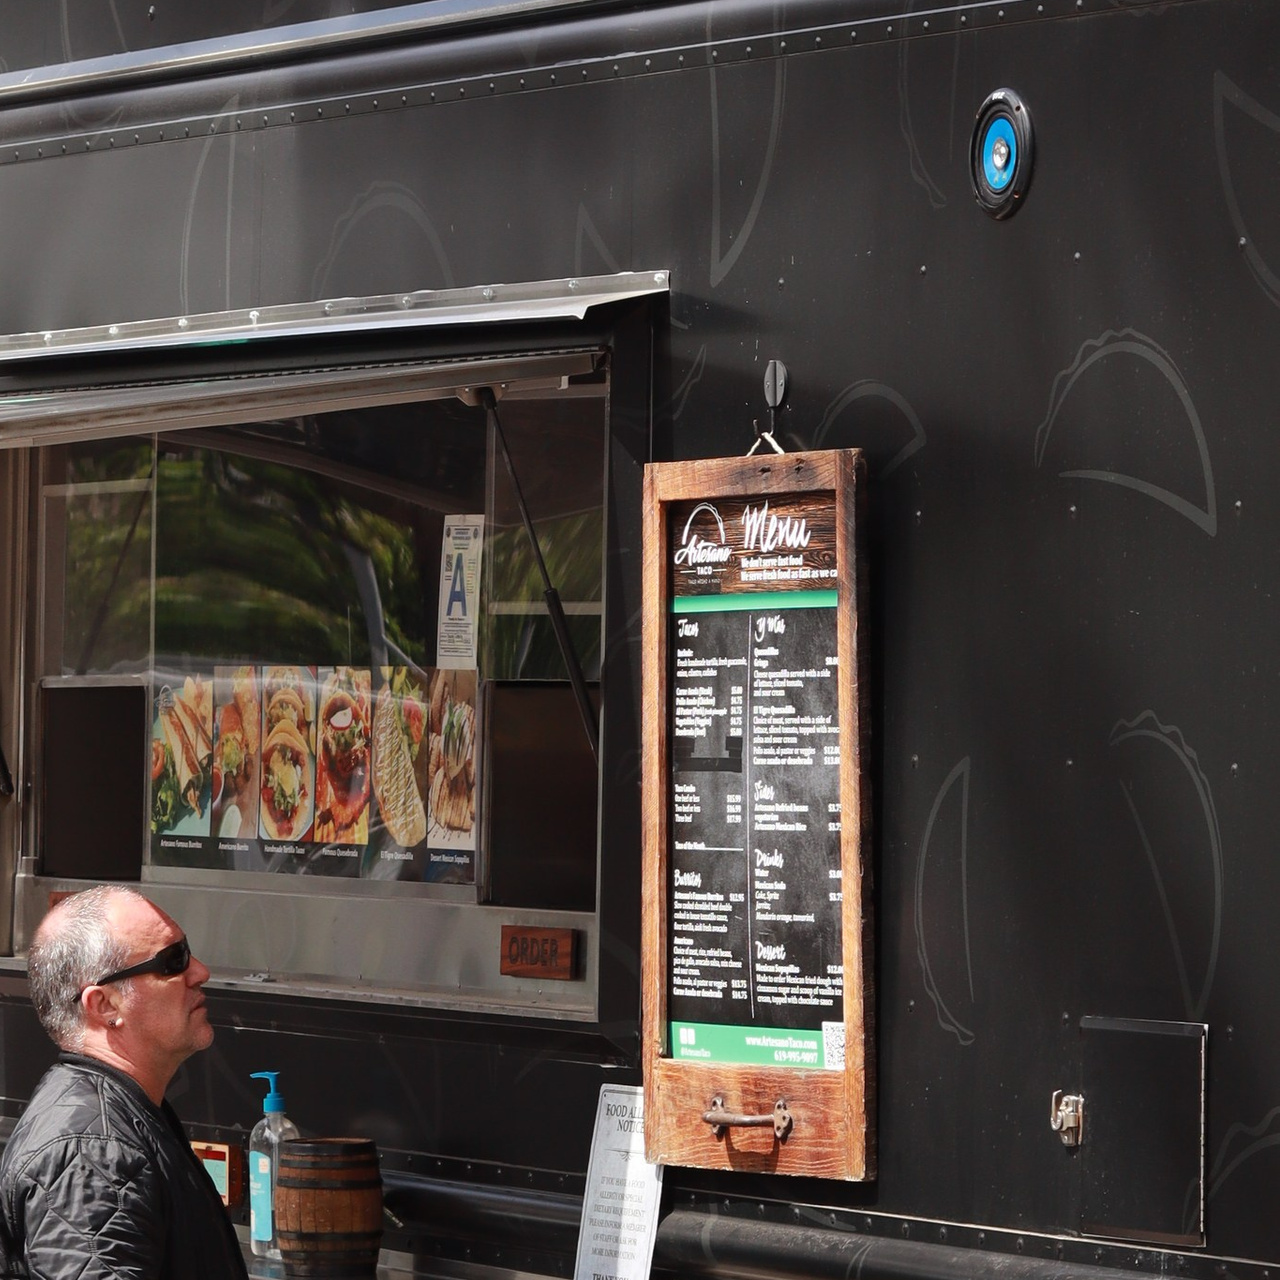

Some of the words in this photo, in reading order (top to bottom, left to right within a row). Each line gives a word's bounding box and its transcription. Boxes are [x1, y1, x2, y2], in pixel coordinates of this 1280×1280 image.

[742, 500, 811, 553] Menu
[674, 535, 732, 566] Artesano
[697, 566, 712, 576] TACO
[763, 556, 777, 567] serve
[778, 555, 789, 566] fast
[789, 555, 803, 566] food
[763, 570, 777, 580] fresh
[778, 569, 791, 579] food
[791, 571, 798, 579] as
[799, 568, 811, 579] fast
[812, 570, 819, 578] as
[820, 569, 830, 578] we
[830, 568, 838, 578] ca
[446, 552, 469, 618] A
[678, 618, 700, 638] Tacos
[754, 780, 775, 801] Sides
[754, 849, 784, 868] Drinks
[508, 936, 558, 967] ORDER
[755, 940, 786, 961] Dessert
[606, 1104, 628, 1118] FOOD
